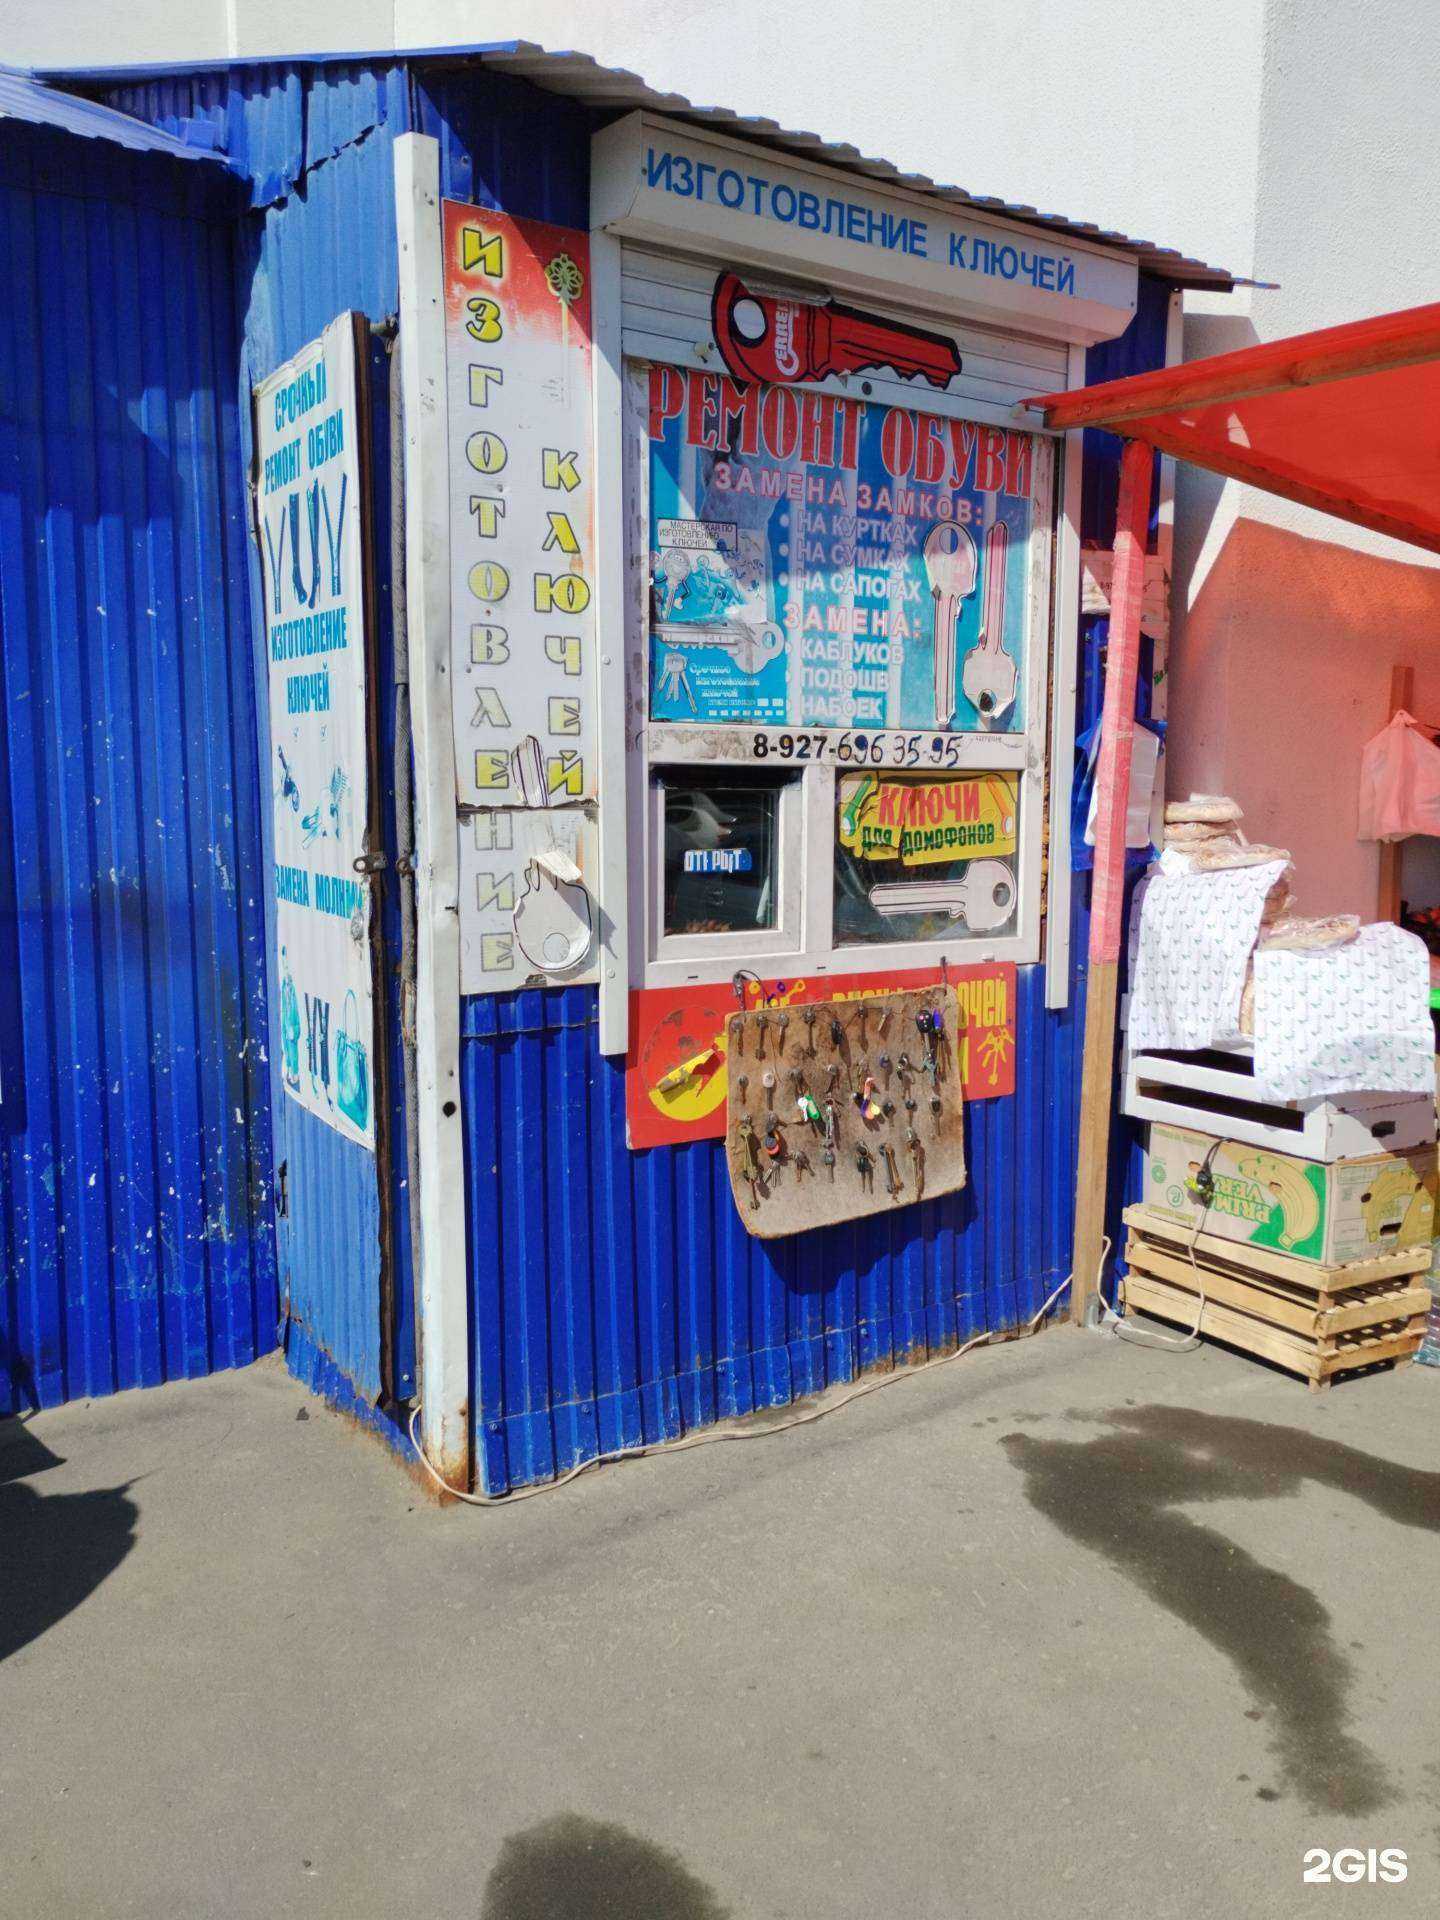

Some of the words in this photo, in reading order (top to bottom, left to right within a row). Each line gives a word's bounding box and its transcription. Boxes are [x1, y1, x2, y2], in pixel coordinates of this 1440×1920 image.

[646, 148, 928, 258] ИЗГОТОВЛЕНИЕ
[949, 232, 1075, 295] КЛЮЧЕЙ
[264, 438, 301, 496] РЕМОНТ
[308, 408, 344, 470] ОБУВИ
[647, 366, 867, 471] РЕМОНТ
[880, 404, 1034, 499] ОБУВИ
[714, 460, 848, 507] ЗАМЕНА
[670, 520, 719, 532] МАСТЕРСКАЯ
[721, 523, 734, 533] ПО
[797, 509, 827, 535] НА
[832, 514, 918, 546] КУРТКАХ
[796, 538, 826, 564] НА
[830, 543, 911, 576] СУМКАХ
[462, 227, 516, 973] ИЗГОТОВЛЕНИЕ
[796, 567, 826, 593] НА
[830, 571, 922, 604] САПОГАХ
[271, 606, 347, 662] ИЗГОТОВЛЕНИЕ
[533, 447, 591, 796] КЛЮЧЕЙ
[800, 637, 906, 666] КАБЛУКОВ
[287, 661, 330, 715] КЛЮЧЕЙ
[800, 666, 890, 693] ПОДОШВ
[800, 694, 884, 720] НАБОЕК
[878, 782, 981, 827] КЛЮЧИ
[862, 825, 894, 852] ДЛЯ
[902, 823, 996, 858] ДОМОФОНОВ
[275, 863, 310, 908] ЗАМЕНА
[1210, 1194, 1273, 1226] PRIM
